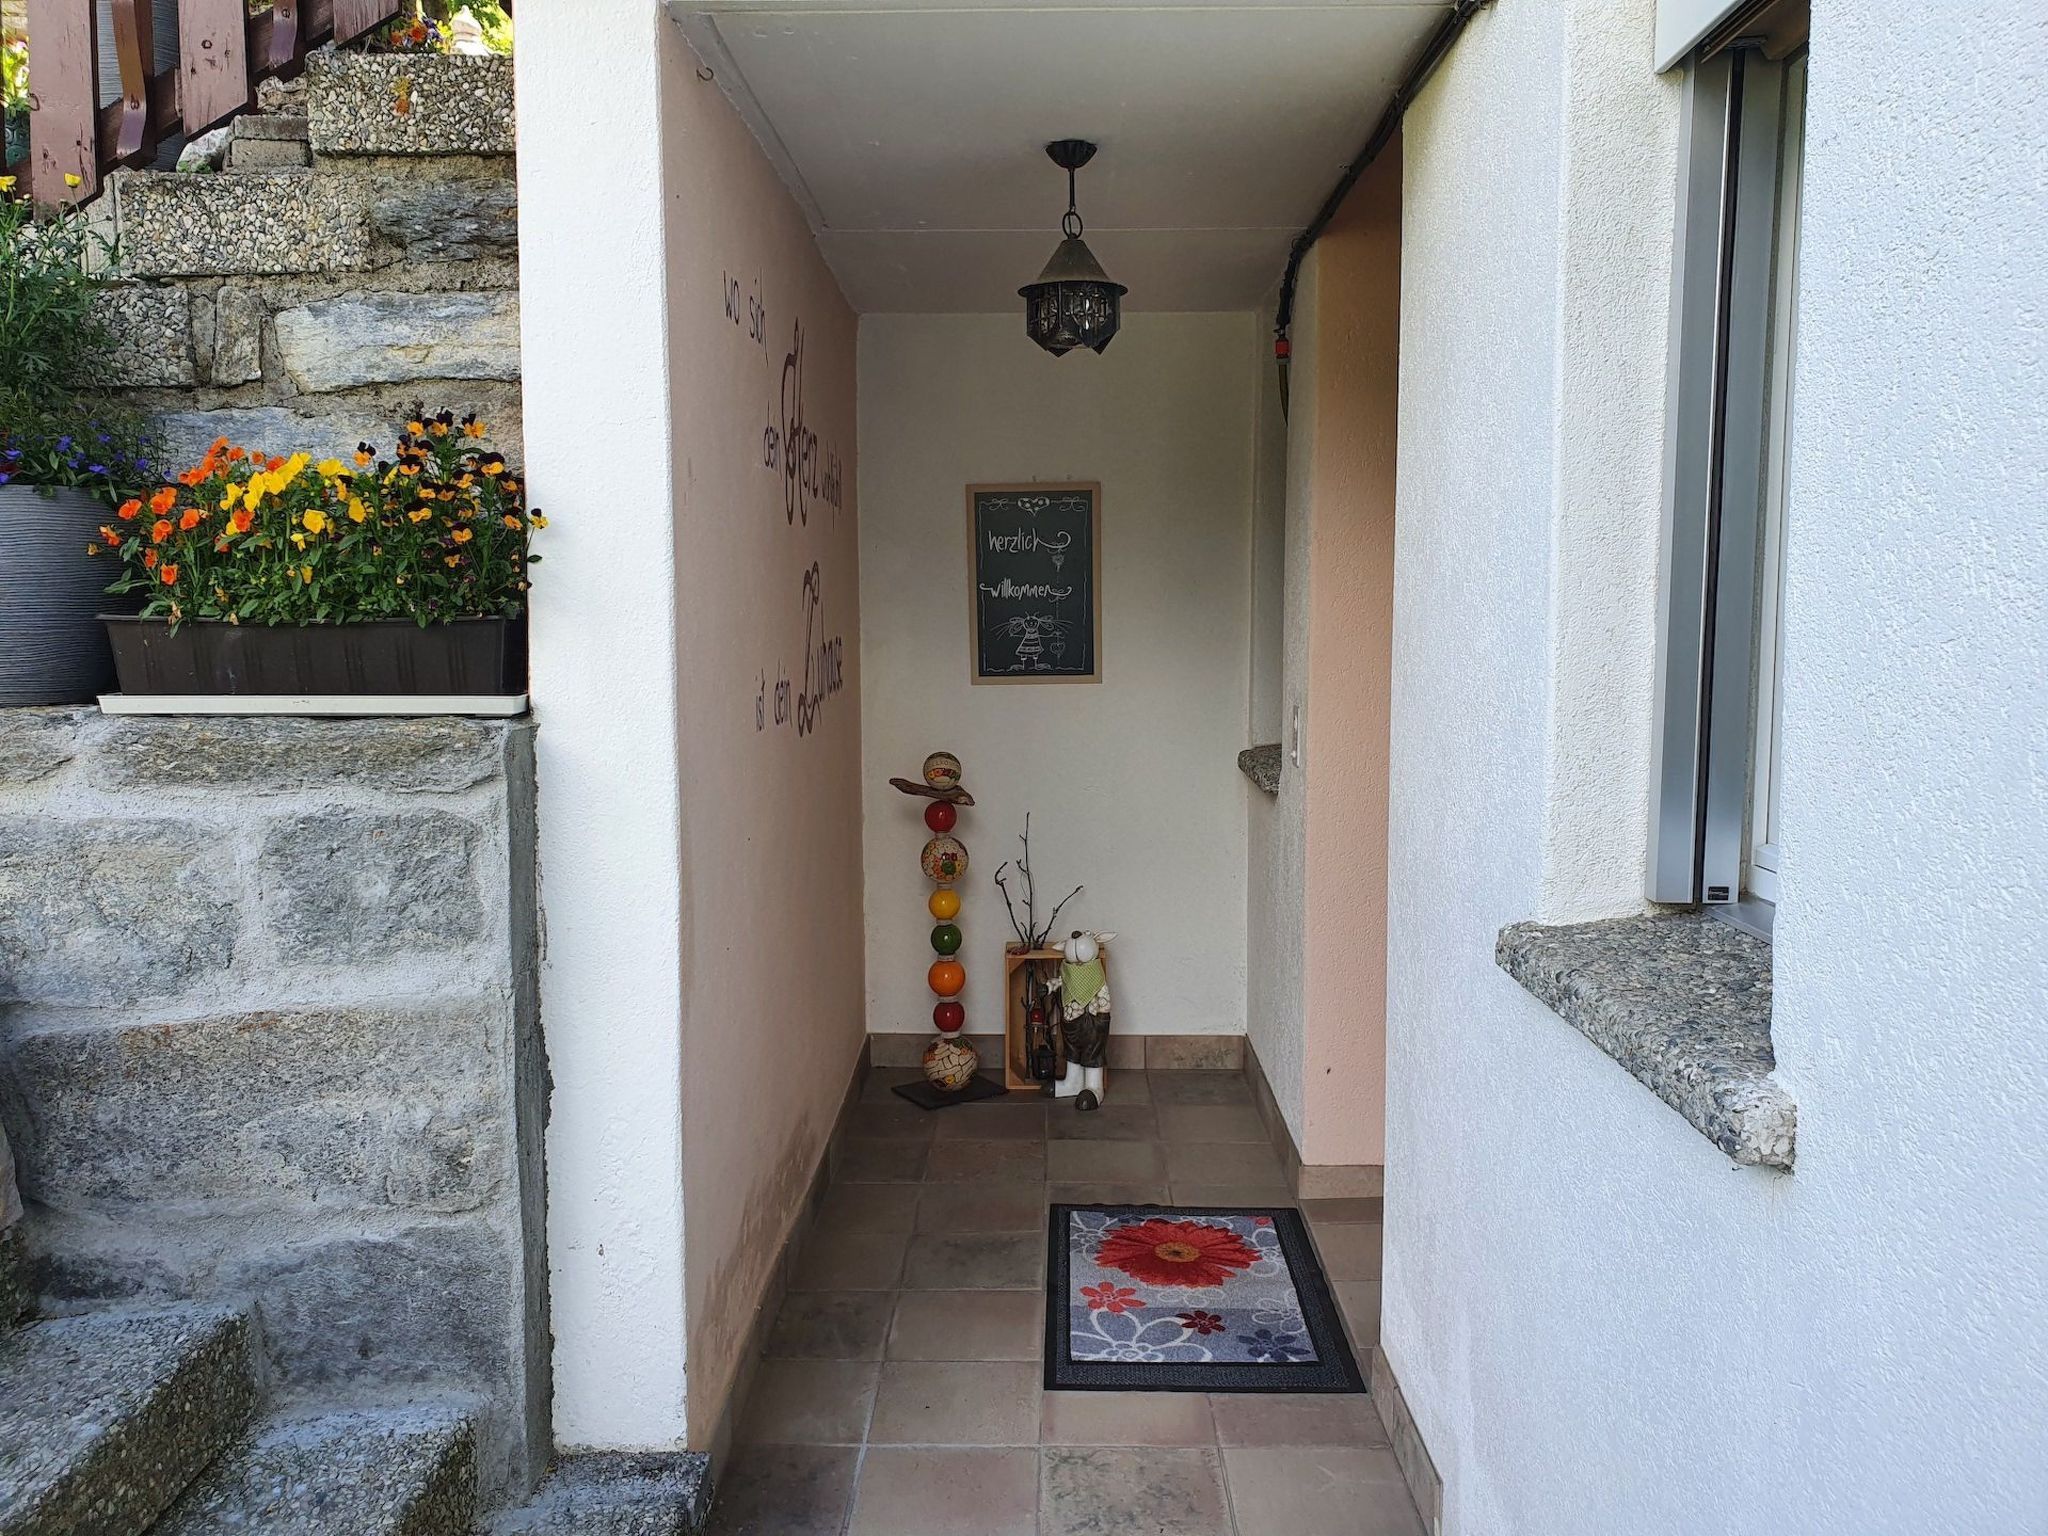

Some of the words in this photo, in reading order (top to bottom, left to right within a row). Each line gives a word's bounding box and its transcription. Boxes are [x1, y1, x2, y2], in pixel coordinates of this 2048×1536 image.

[781, 316, 818, 527] Herz
[979, 577, 1073, 601] willkommen
[774, 656, 793, 729] dein
